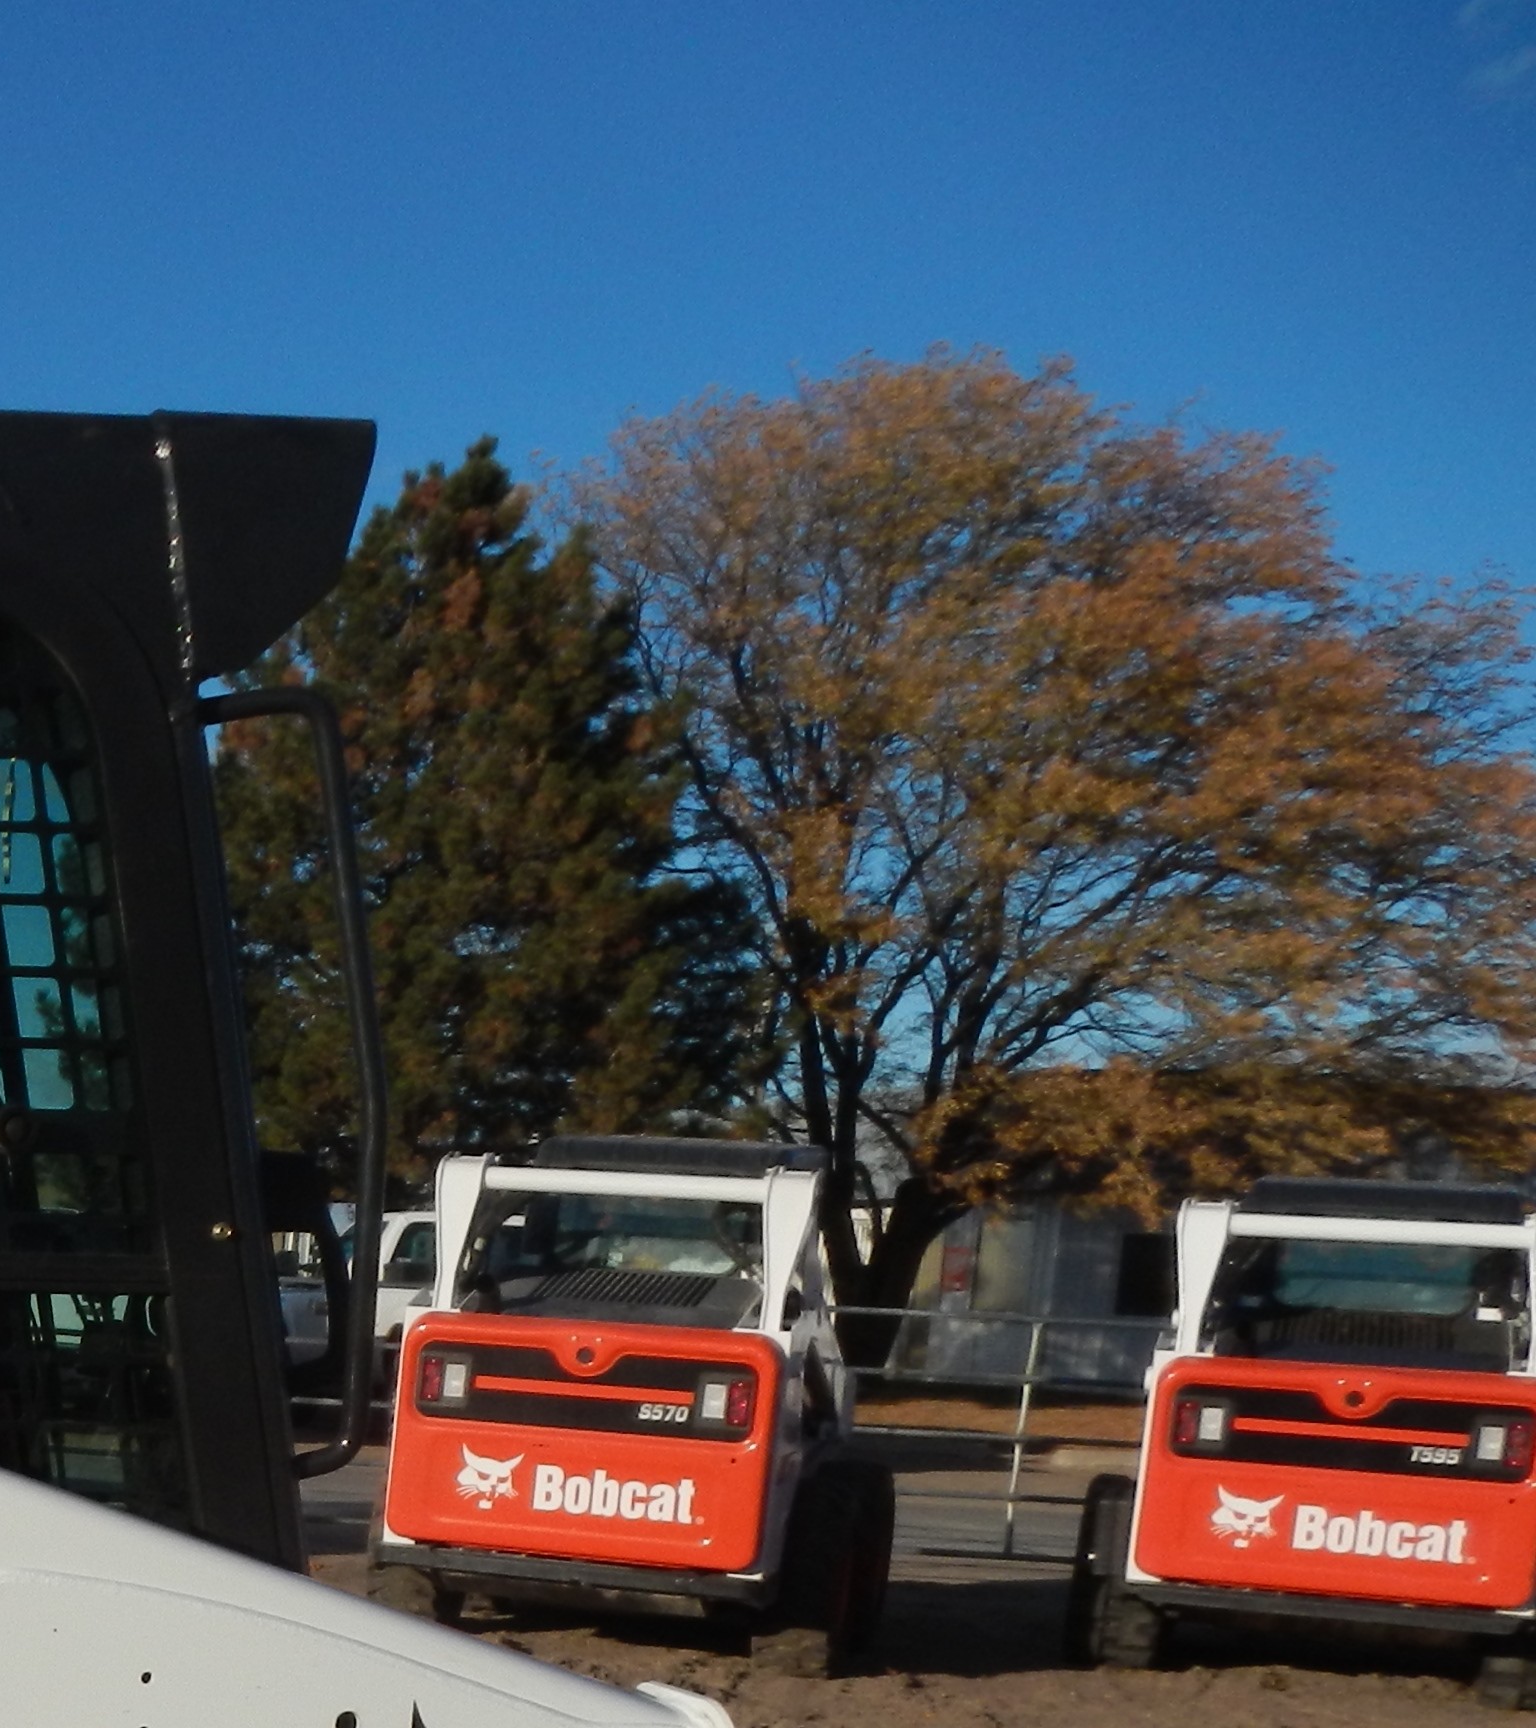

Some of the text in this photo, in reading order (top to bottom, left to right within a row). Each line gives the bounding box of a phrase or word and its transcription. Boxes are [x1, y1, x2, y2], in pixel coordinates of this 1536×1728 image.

[638, 1403, 689, 1423] S570
[1410, 1446, 1462, 1465] T595
[533, 1464, 695, 1525] Bobcat
[1292, 1504, 1468, 1564] Bobcat
